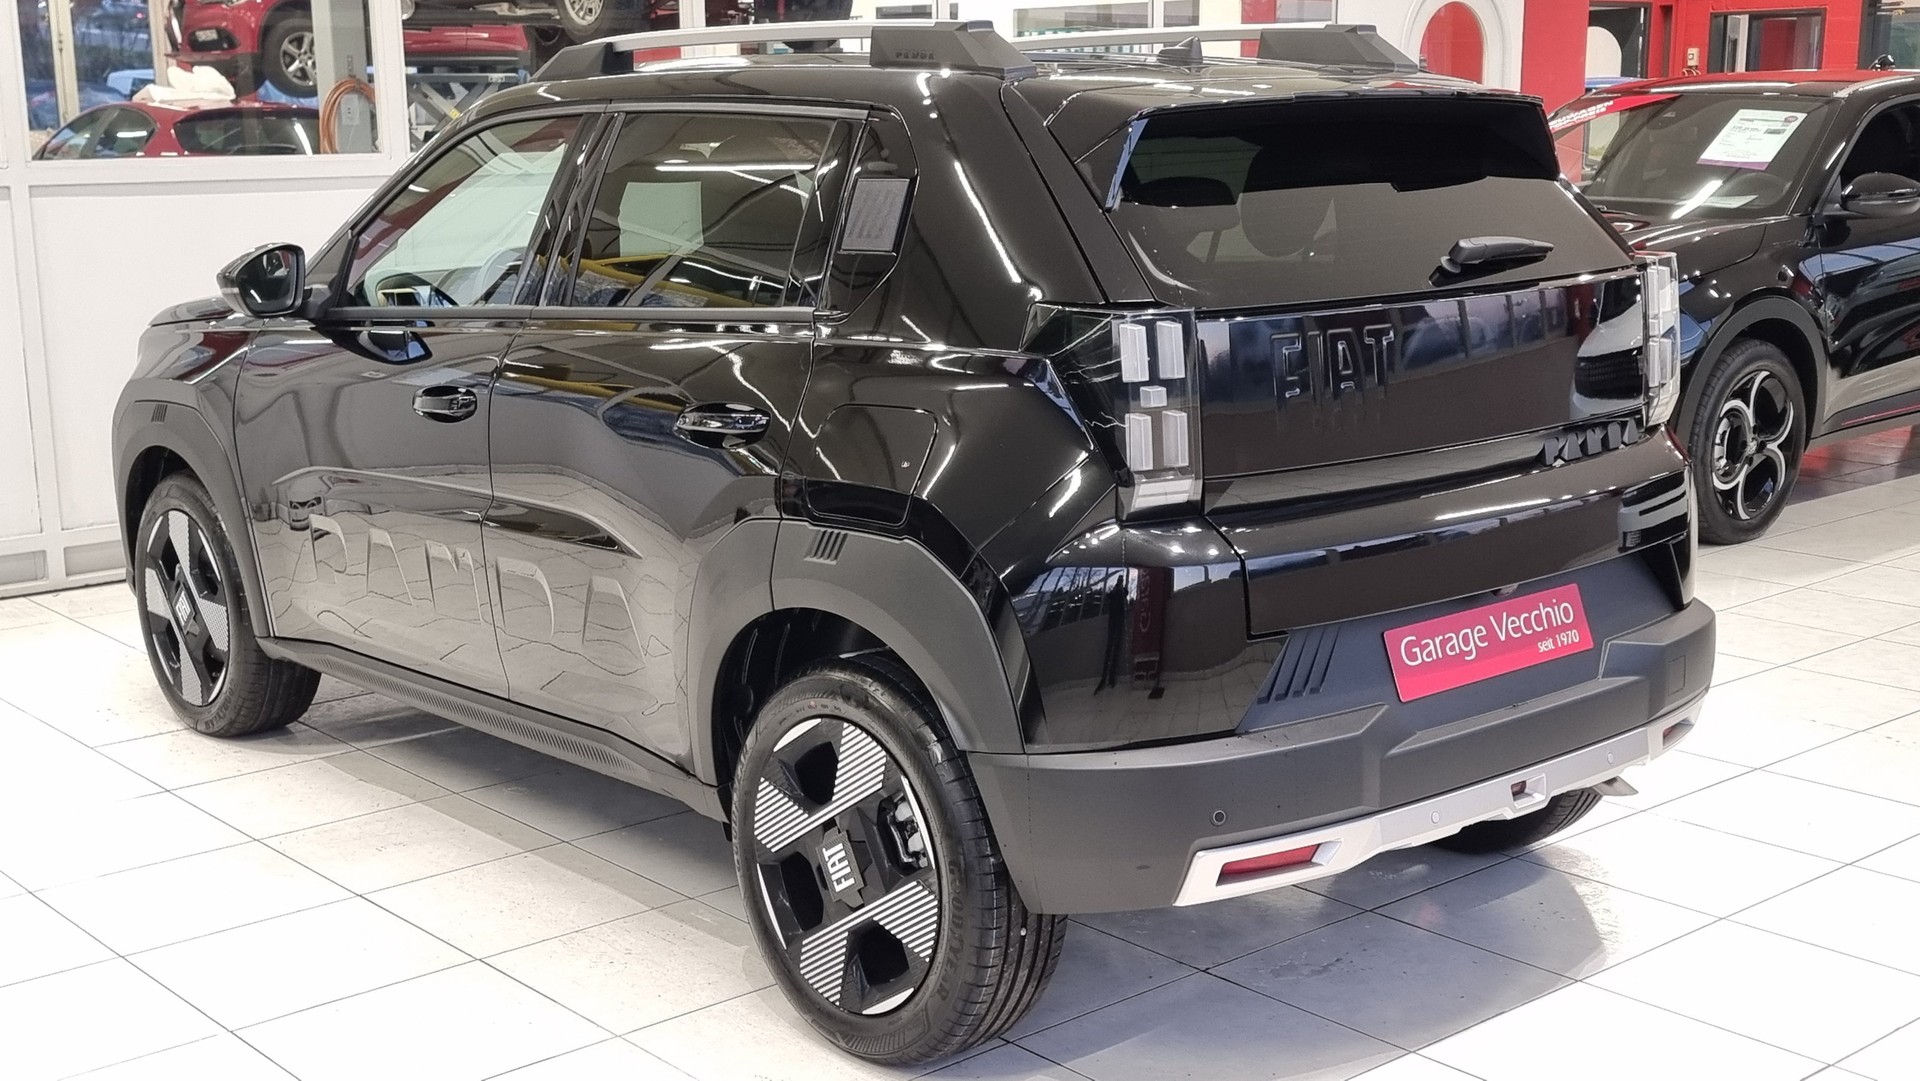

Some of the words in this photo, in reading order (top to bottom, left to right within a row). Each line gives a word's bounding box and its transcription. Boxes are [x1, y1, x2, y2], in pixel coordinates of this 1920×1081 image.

[1271, 323, 1395, 408] FIAT
[307, 513, 647, 667] PANDA
[1400, 625, 1488, 666] Garage
[1489, 599, 1574, 642] Vecchio
[1537, 636, 1555, 653] seit
[1556, 629, 1580, 648] 1970
[822, 843, 856, 893] FIAT
[935, 858, 966, 1001] GOODYEAR
